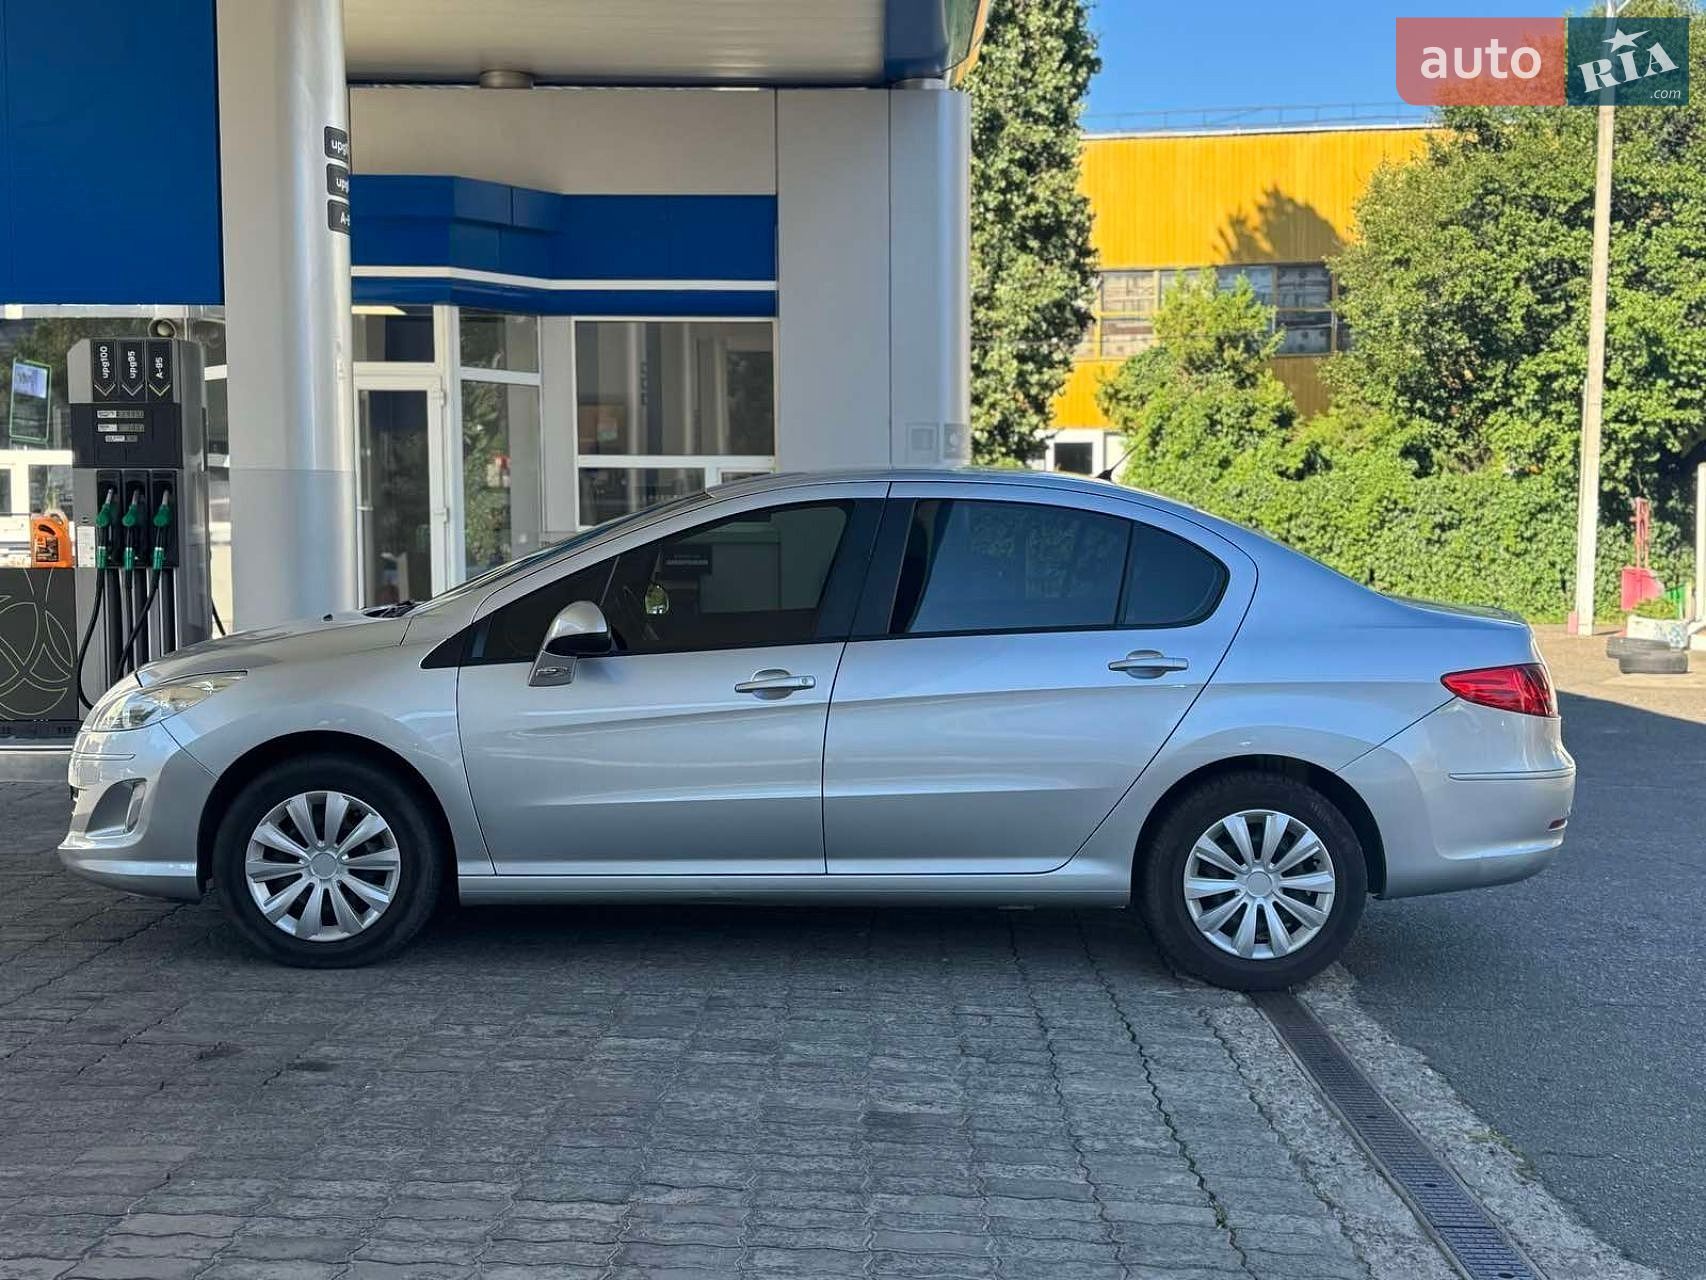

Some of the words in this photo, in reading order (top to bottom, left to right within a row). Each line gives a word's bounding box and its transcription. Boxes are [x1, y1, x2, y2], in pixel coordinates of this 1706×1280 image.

[99, 346, 111, 379] upg100
[127, 351, 138, 379] upg95
[155, 356, 164, 379] A-95
